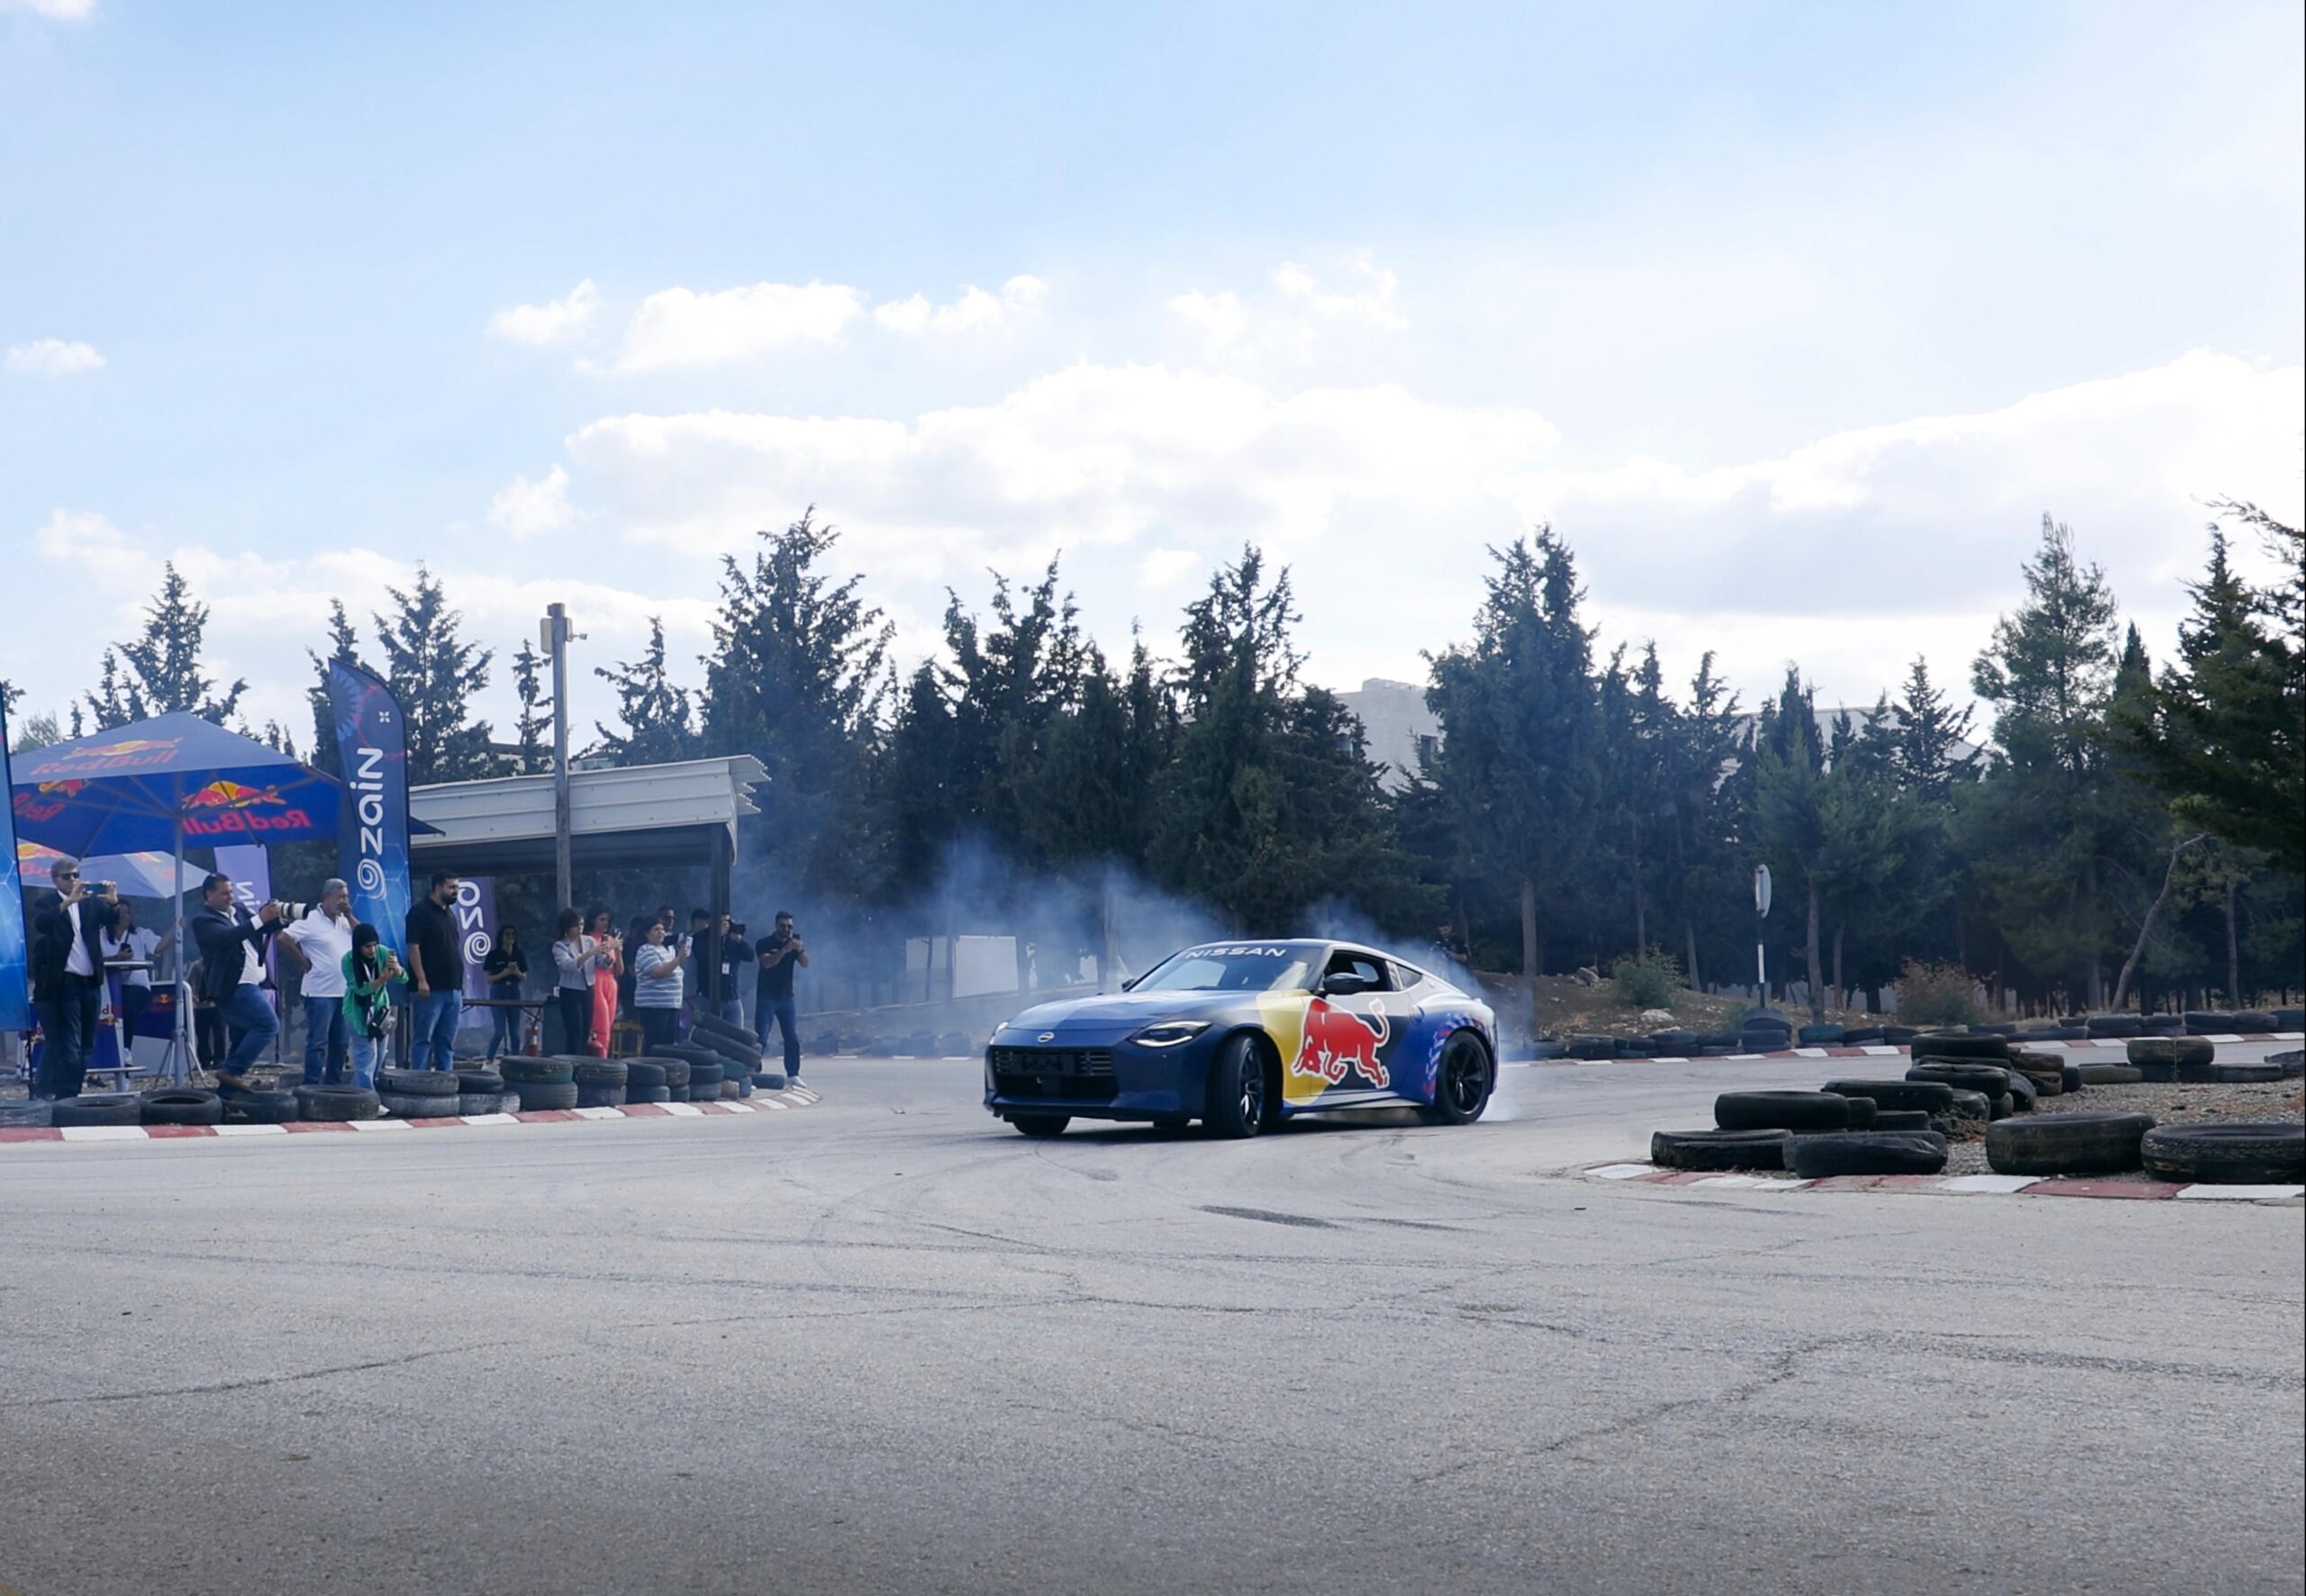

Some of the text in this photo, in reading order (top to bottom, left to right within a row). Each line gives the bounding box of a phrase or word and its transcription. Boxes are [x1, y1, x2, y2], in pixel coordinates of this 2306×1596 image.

[30, 749, 179, 775] Red Bull
[1185, 947, 1286, 959] NISSAN
